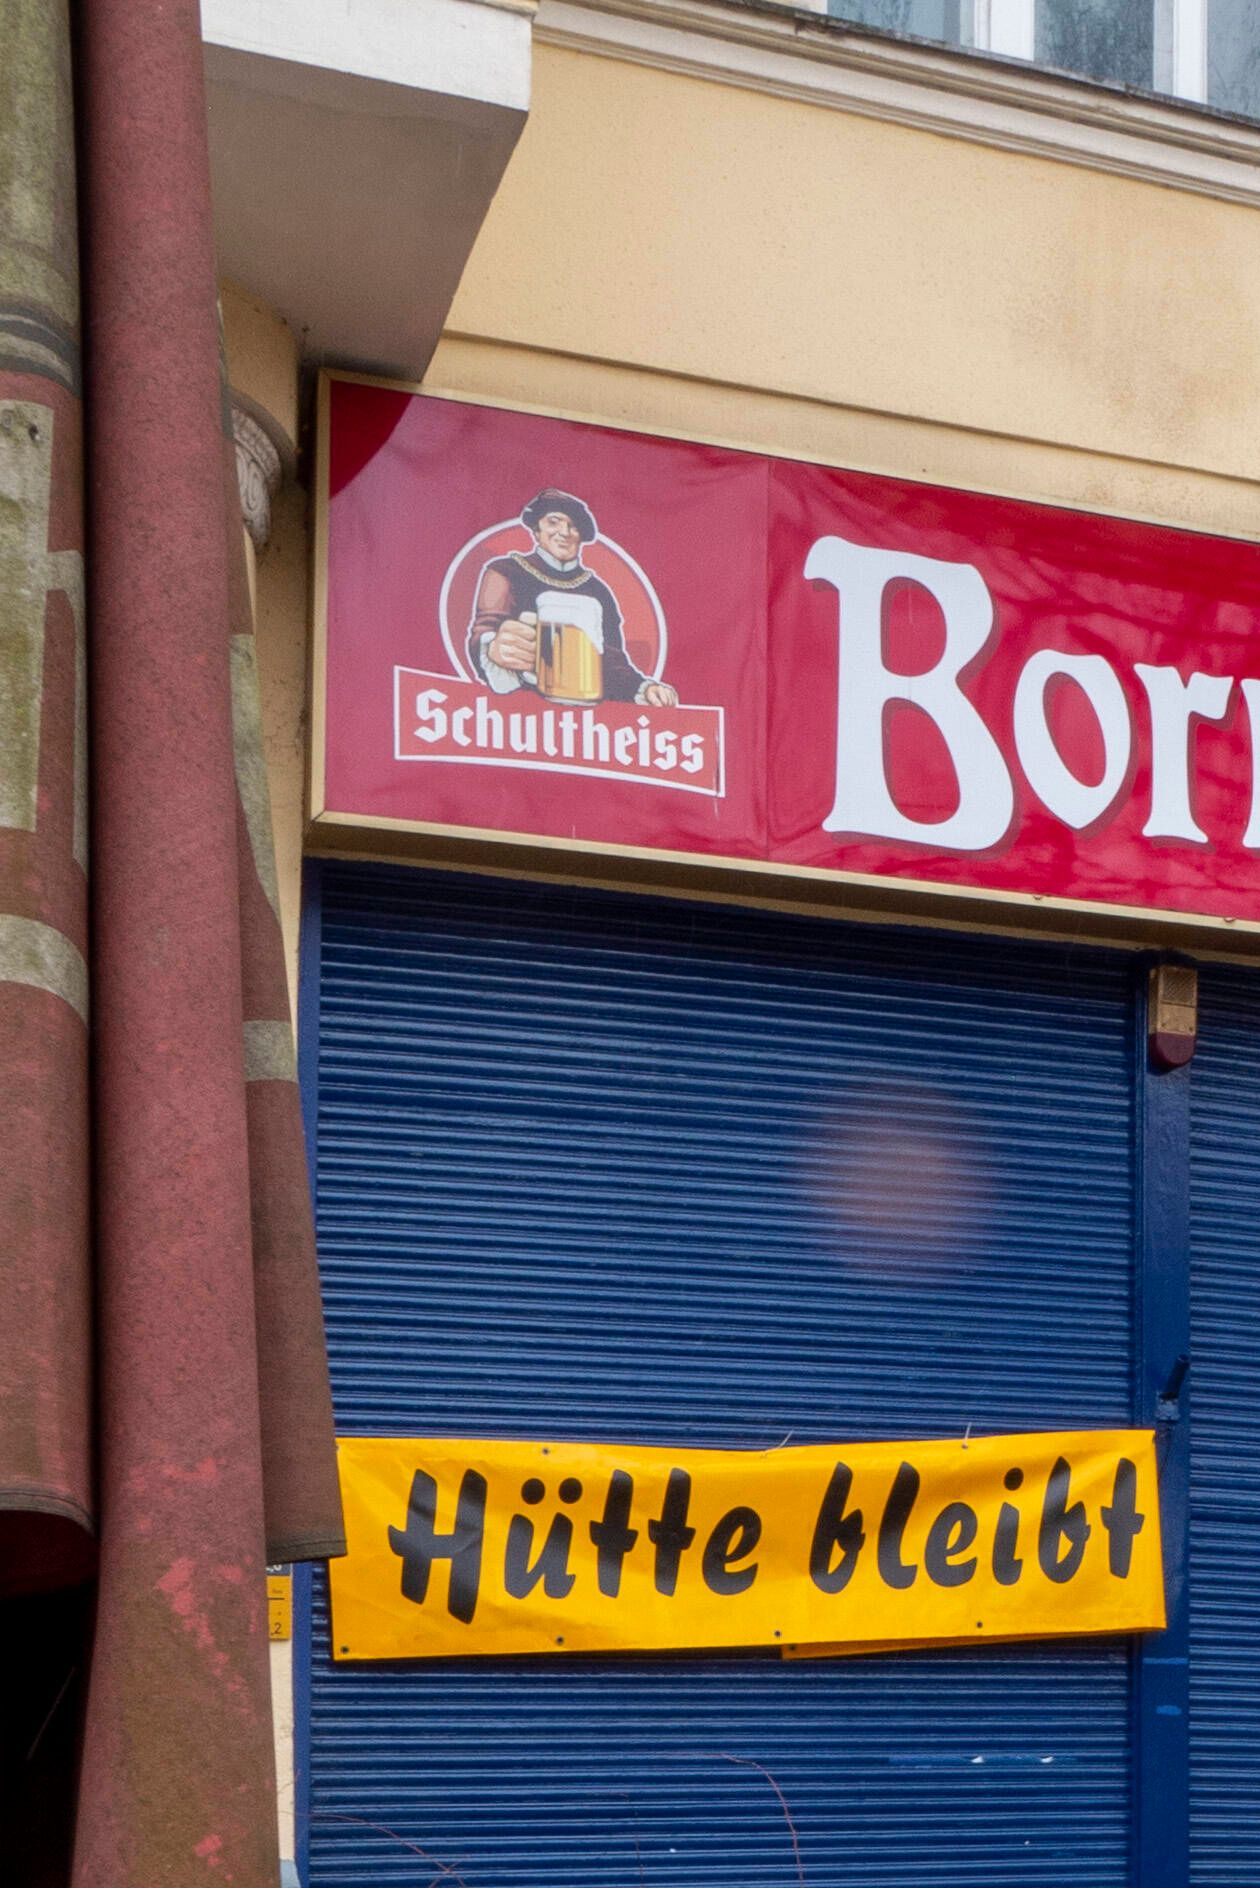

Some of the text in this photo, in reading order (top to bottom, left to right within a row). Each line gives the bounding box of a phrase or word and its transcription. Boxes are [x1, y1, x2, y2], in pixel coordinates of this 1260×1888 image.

[413, 688, 705, 774] Schultheiss
[387, 1455, 1146, 1625] Hütte bleibt
